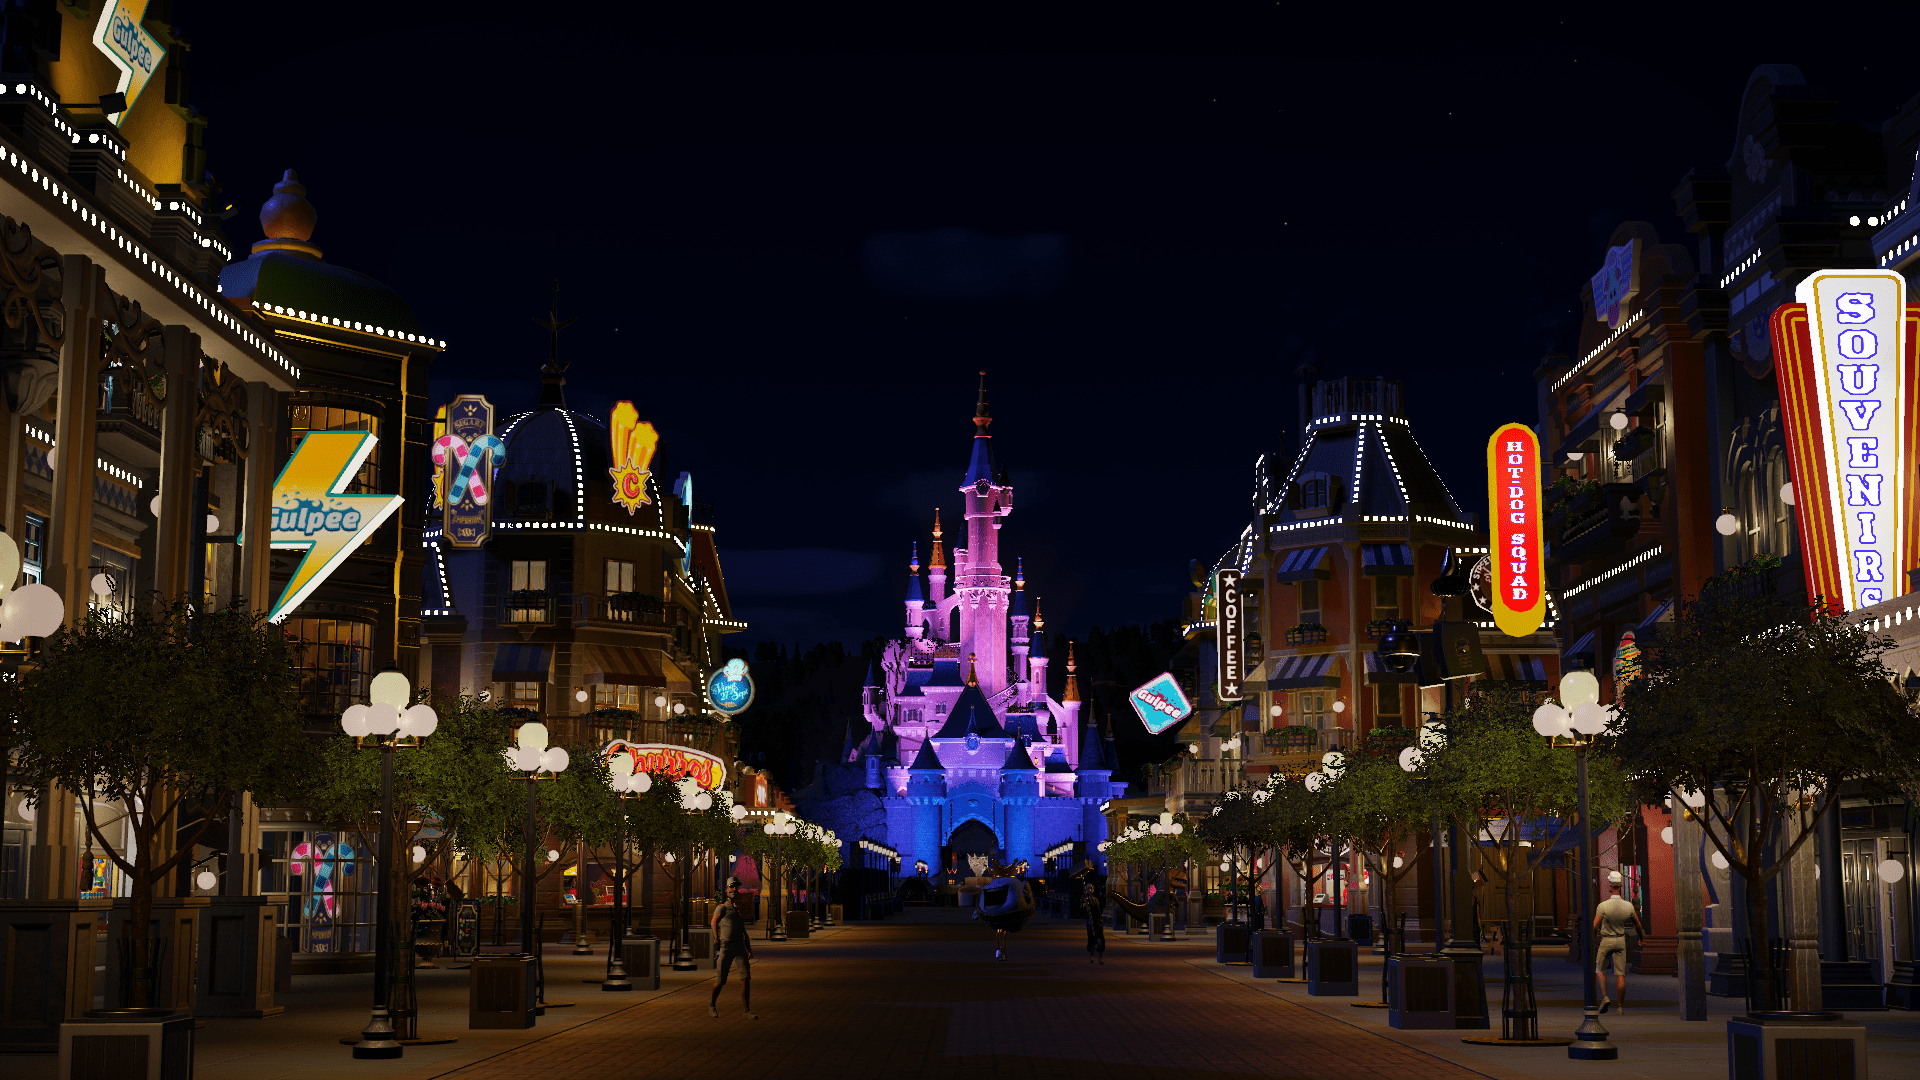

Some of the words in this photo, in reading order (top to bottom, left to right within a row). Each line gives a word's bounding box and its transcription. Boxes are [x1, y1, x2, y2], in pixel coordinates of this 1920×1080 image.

[113, 16, 152, 73] Gulpee
[622, 472, 640, 499] C
[1506, 441, 1526, 525] HOT-DOG
[1510, 533, 1528, 600] SQUAD
[1225, 589, 1237, 680] COFFEE
[1137, 689, 1182, 720] Gulpee
[607, 743, 712, 787] hurros
